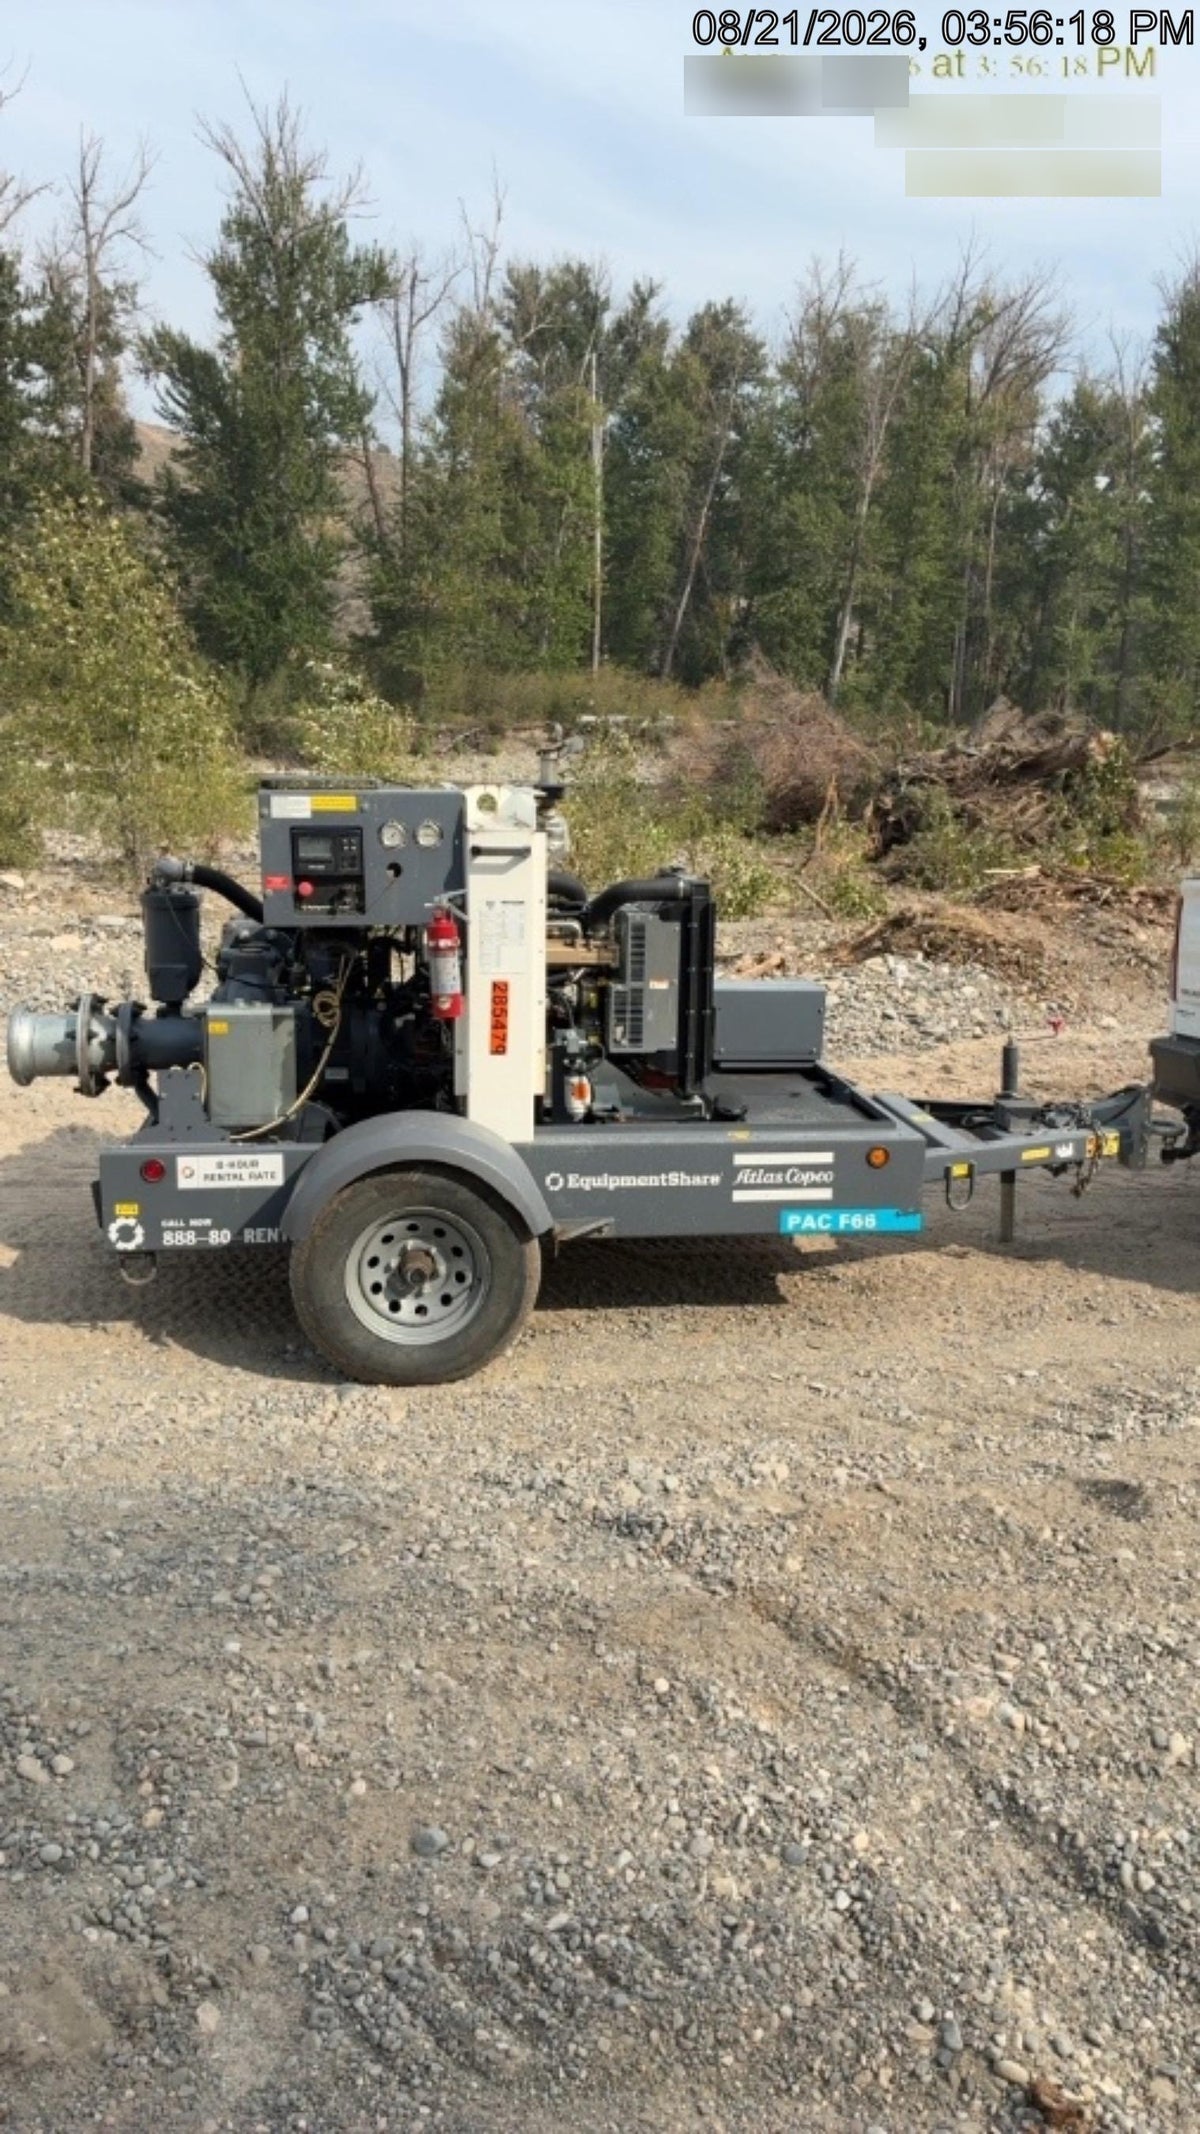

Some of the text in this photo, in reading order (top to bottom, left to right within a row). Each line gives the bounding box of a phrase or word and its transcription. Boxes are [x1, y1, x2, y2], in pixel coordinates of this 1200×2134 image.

[490, 981, 508, 1055] 285479
[567, 1171, 722, 1191] EquipmentShare
[732, 1167, 834, 1186] Atlas Copco
[189, 1218, 212, 1227] NOW
[787, 1214, 831, 1230] PAC
